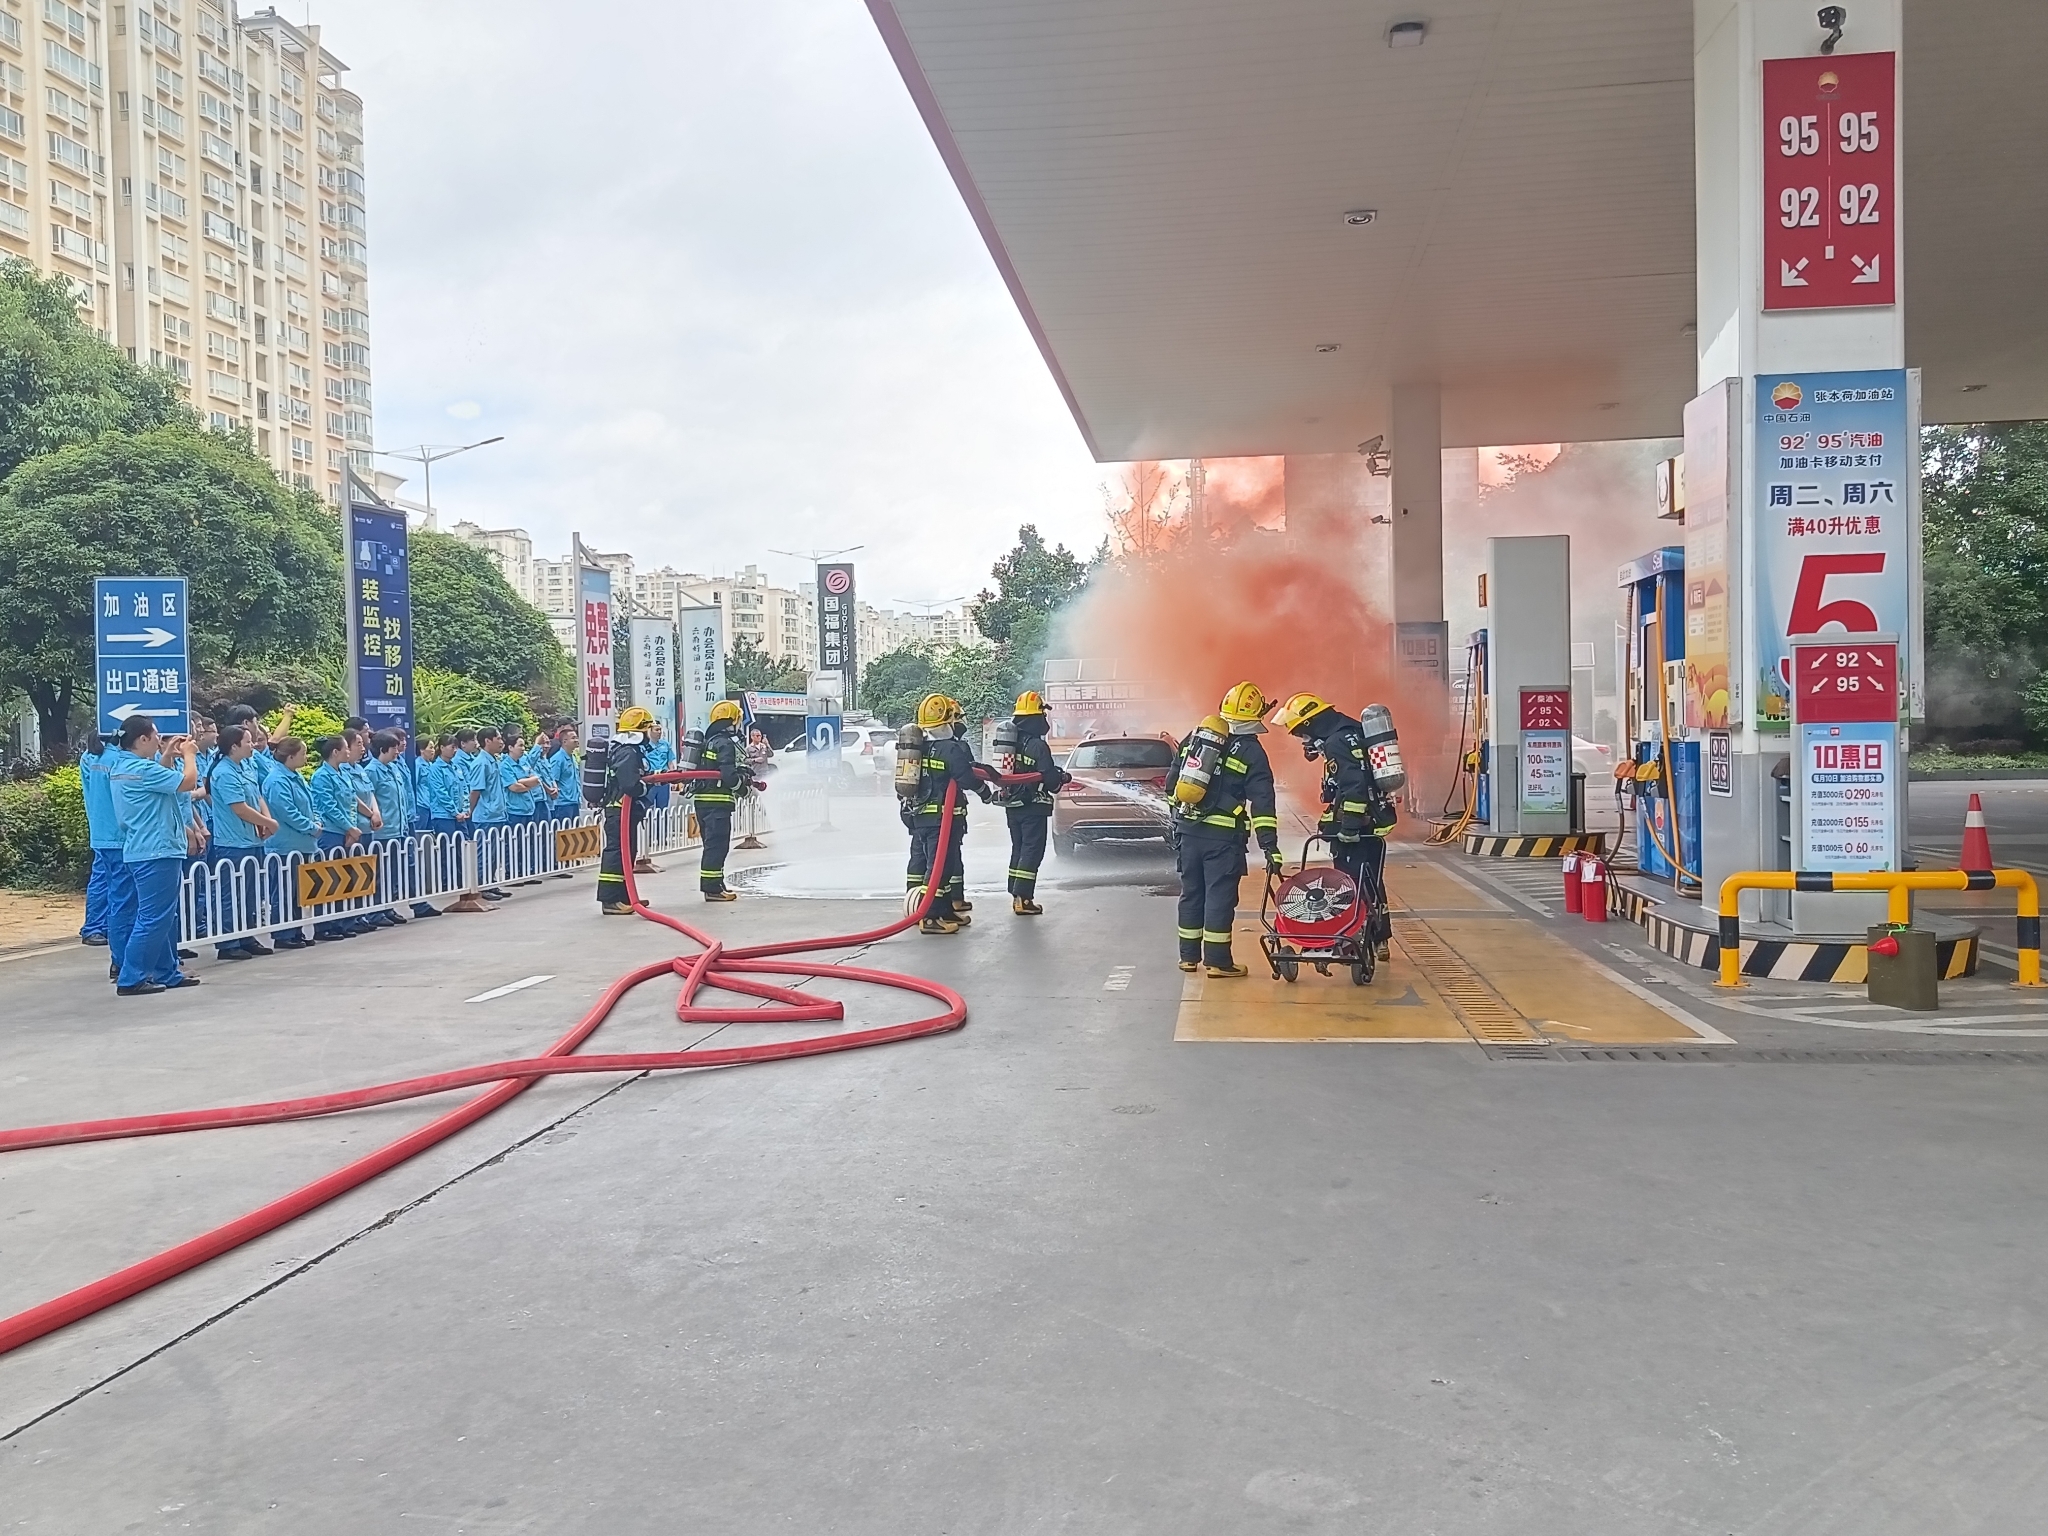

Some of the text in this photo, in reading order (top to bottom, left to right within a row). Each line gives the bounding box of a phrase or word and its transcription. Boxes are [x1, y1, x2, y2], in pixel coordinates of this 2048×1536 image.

[1780, 111, 1880, 156] 95 95
[1780, 183, 1880, 228] 92 92
[1814, 388, 1894, 402] 张本荷加油站
[1763, 412, 1812, 424] 中国石油
[1779, 454, 1883, 470] 加油卡移动支付
[1769, 481, 1894, 507] 周二、周六
[1787, 515, 1882, 537] 满40升优惠
[103, 592, 177, 618] 加油区
[361, 578, 382, 657] 装监控
[585, 600, 609, 655] 免费
[823, 596, 841, 665] 国福集团
[383, 616, 404, 696] 找移动
[703, 626, 716, 702] 办会员拿出厂价
[1836, 652, 1859, 667] 92
[106, 668, 180, 694] 出口通道
[587, 661, 612, 716] 洗车
[1836, 676, 1860, 692] 95
[1538, 718, 1551, 727] 92
[1540, 706, 1552, 715] 95
[1813, 744, 1882, 769] 10惠日
